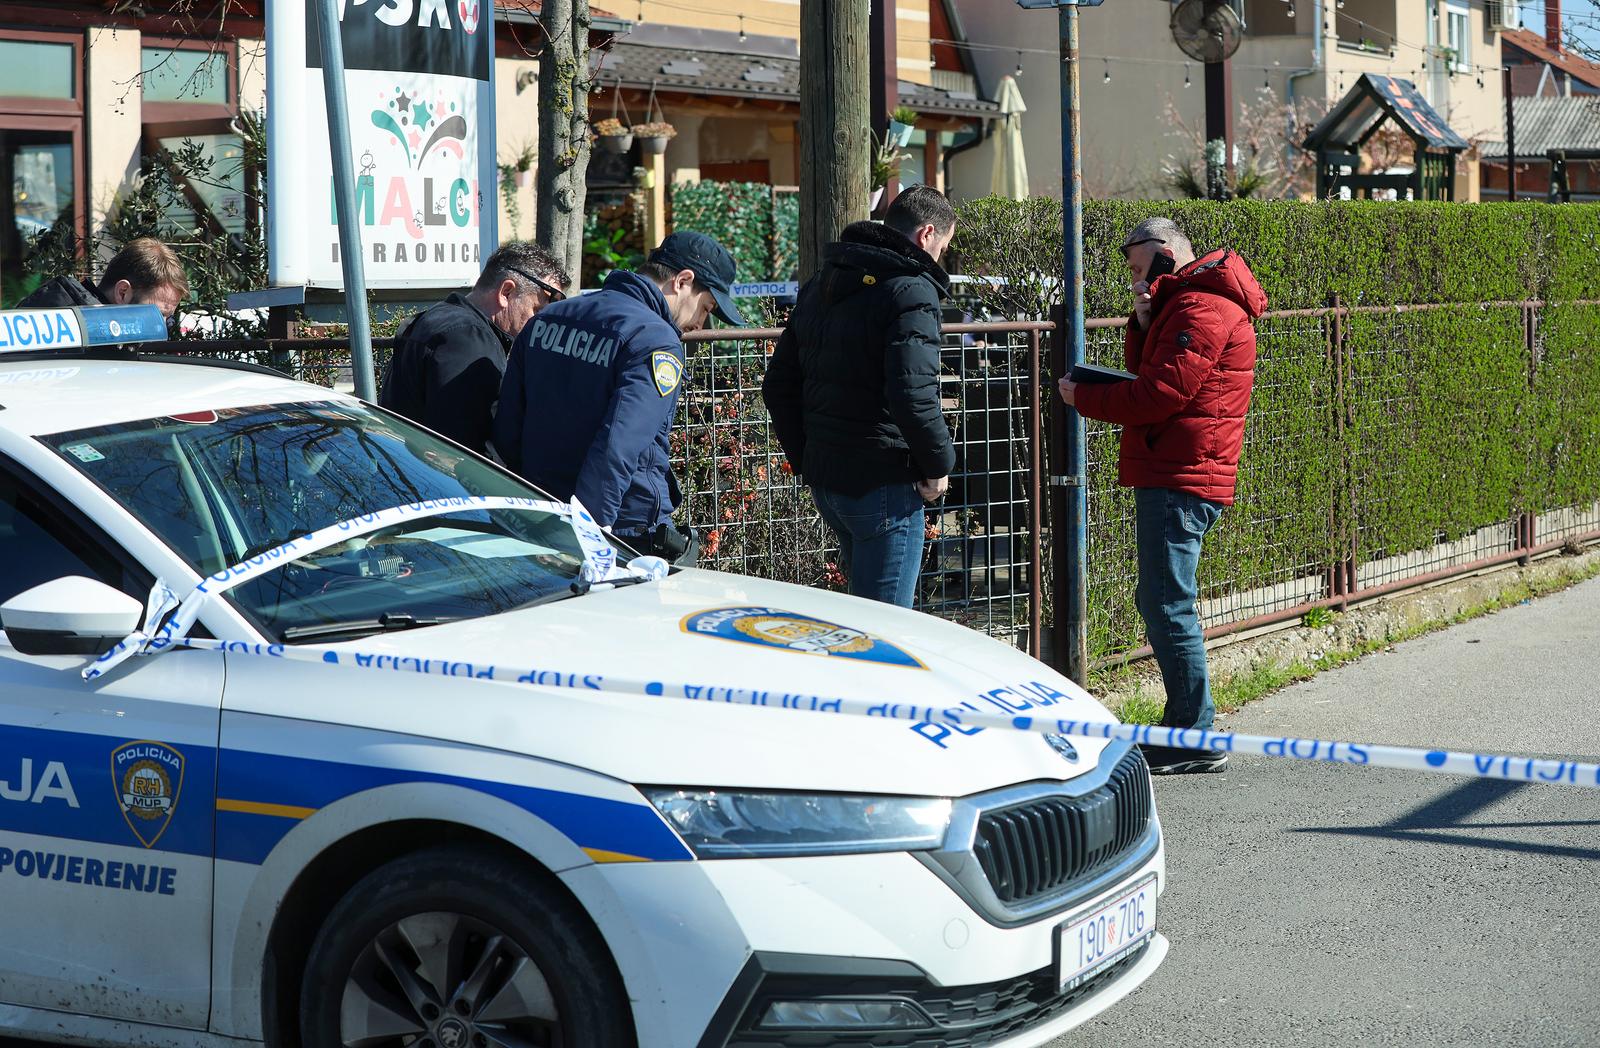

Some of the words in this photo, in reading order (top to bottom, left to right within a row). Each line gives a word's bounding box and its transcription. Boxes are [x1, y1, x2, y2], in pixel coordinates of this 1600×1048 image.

[331, 242, 481, 263] IRAONICA
[733, 283, 787, 296] POLICIJA
[529, 318, 617, 368] POLICIJA
[117, 747, 180, 769] POLICIJA
[1263, 737, 1371, 765] STOP
[0, 757, 80, 808] JA
[134, 776, 160, 796] RH
[132, 797, 162, 807] MUP
[0, 847, 177, 896] POVJERENJE
[1079, 915, 1106, 968] 190
[1119, 892, 1145, 945] 706
